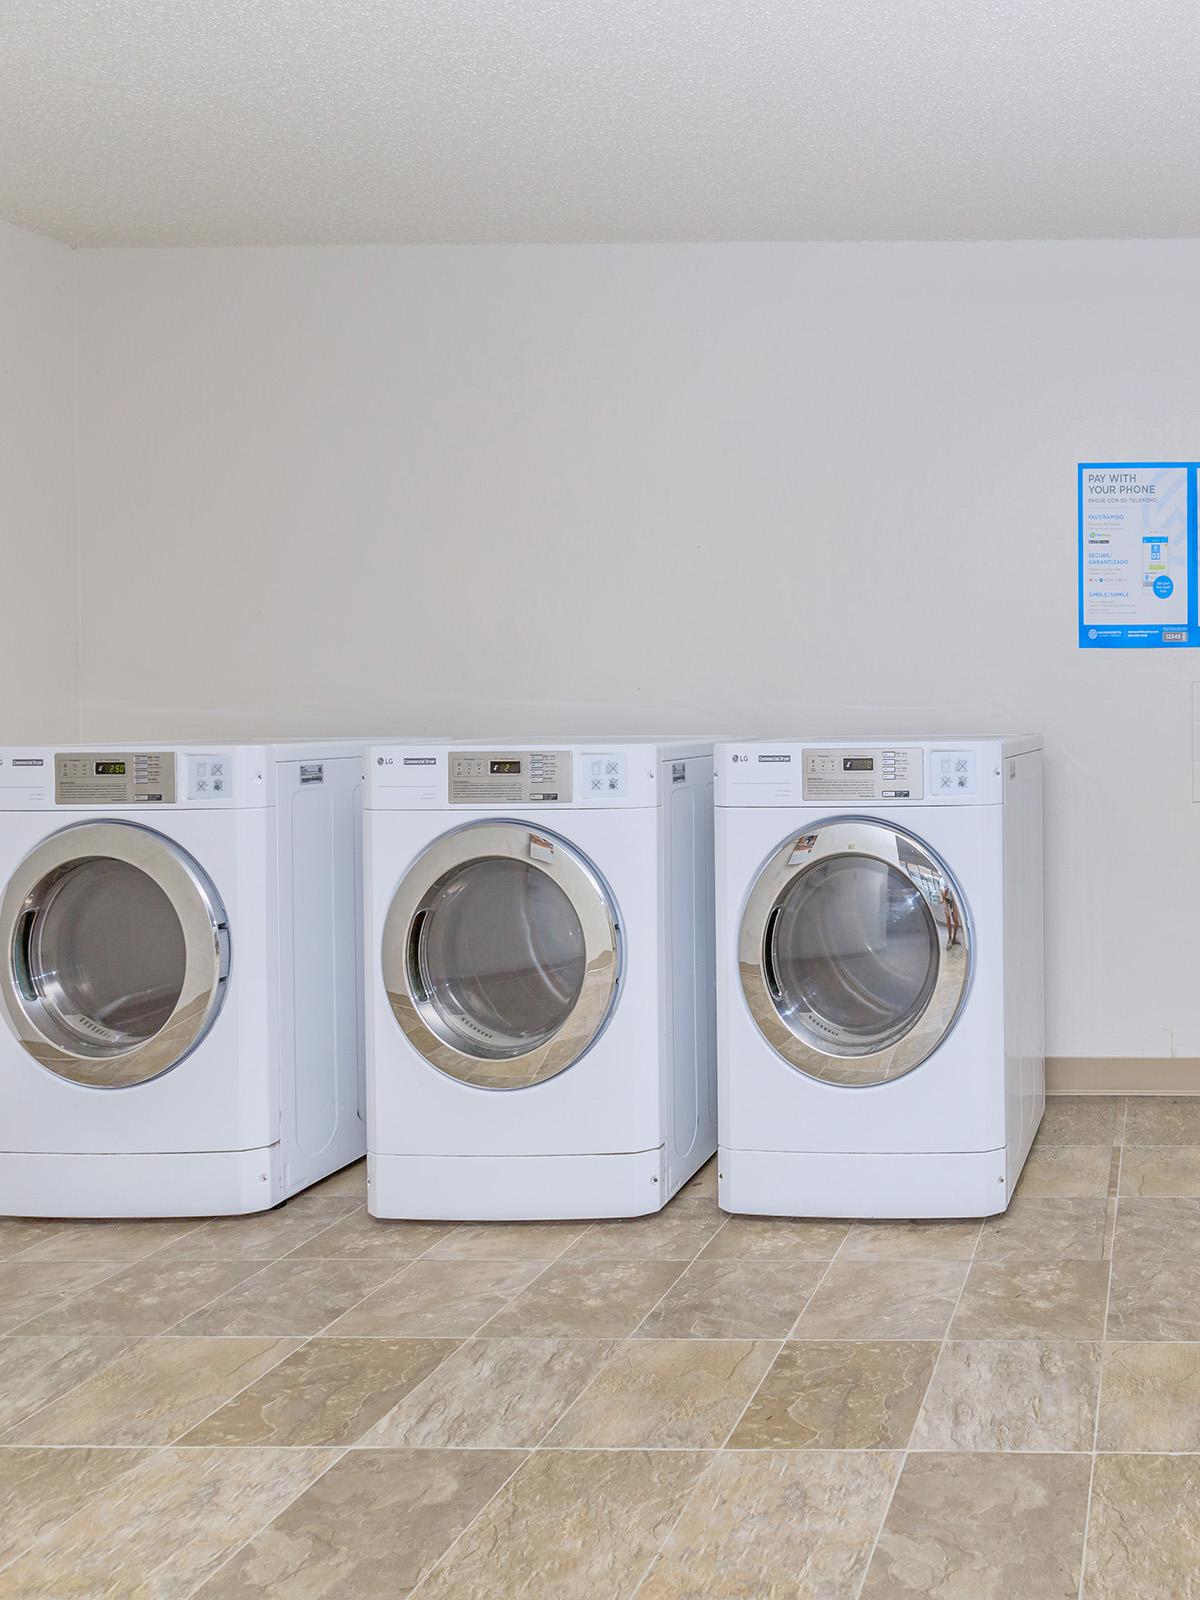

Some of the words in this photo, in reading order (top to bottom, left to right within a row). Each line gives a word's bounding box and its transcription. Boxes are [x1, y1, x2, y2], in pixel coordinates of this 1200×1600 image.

[1088, 474, 1106, 483] PAY
[1109, 474, 1136, 482] WITH
[1089, 485, 1116, 494] YOUR
[1120, 485, 1156, 494] PHONE
